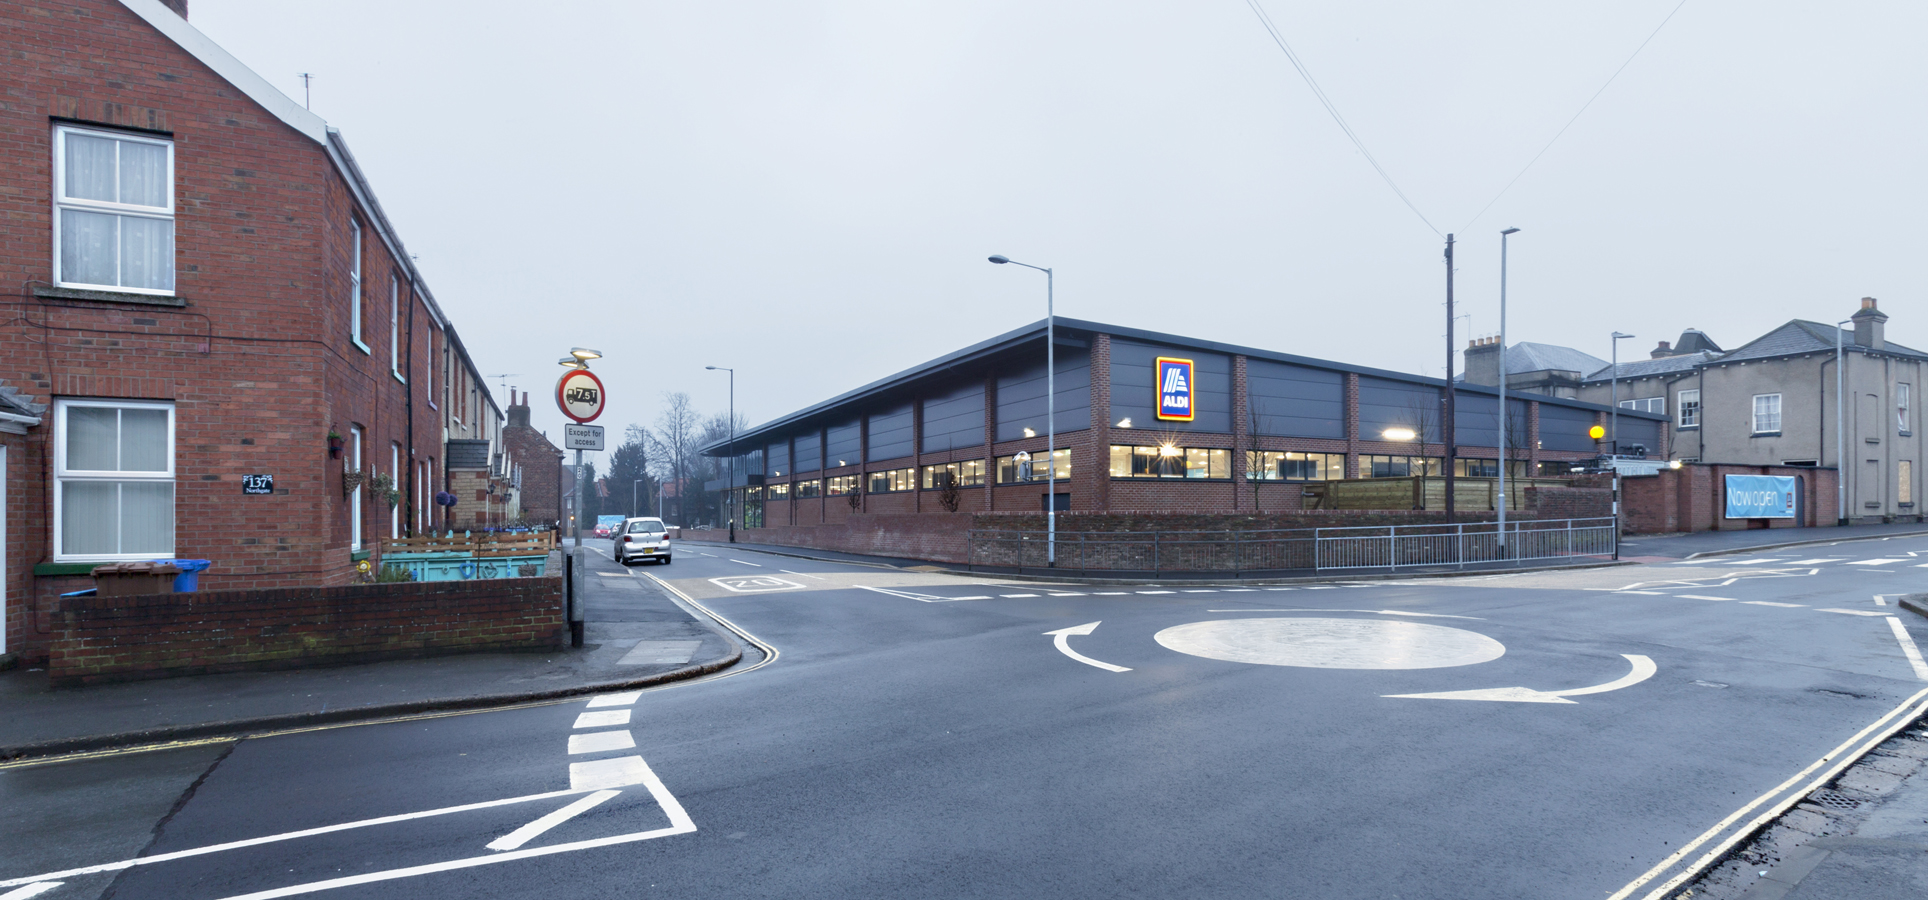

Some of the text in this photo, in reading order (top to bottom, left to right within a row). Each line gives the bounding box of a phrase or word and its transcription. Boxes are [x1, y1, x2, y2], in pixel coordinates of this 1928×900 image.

[1163, 395, 1189, 408] ALDI
[568, 428, 591, 437] Except
[249, 477, 267, 488] 137
[1728, 487, 1778, 511] Now open
[727, 579, 783, 588] 20
